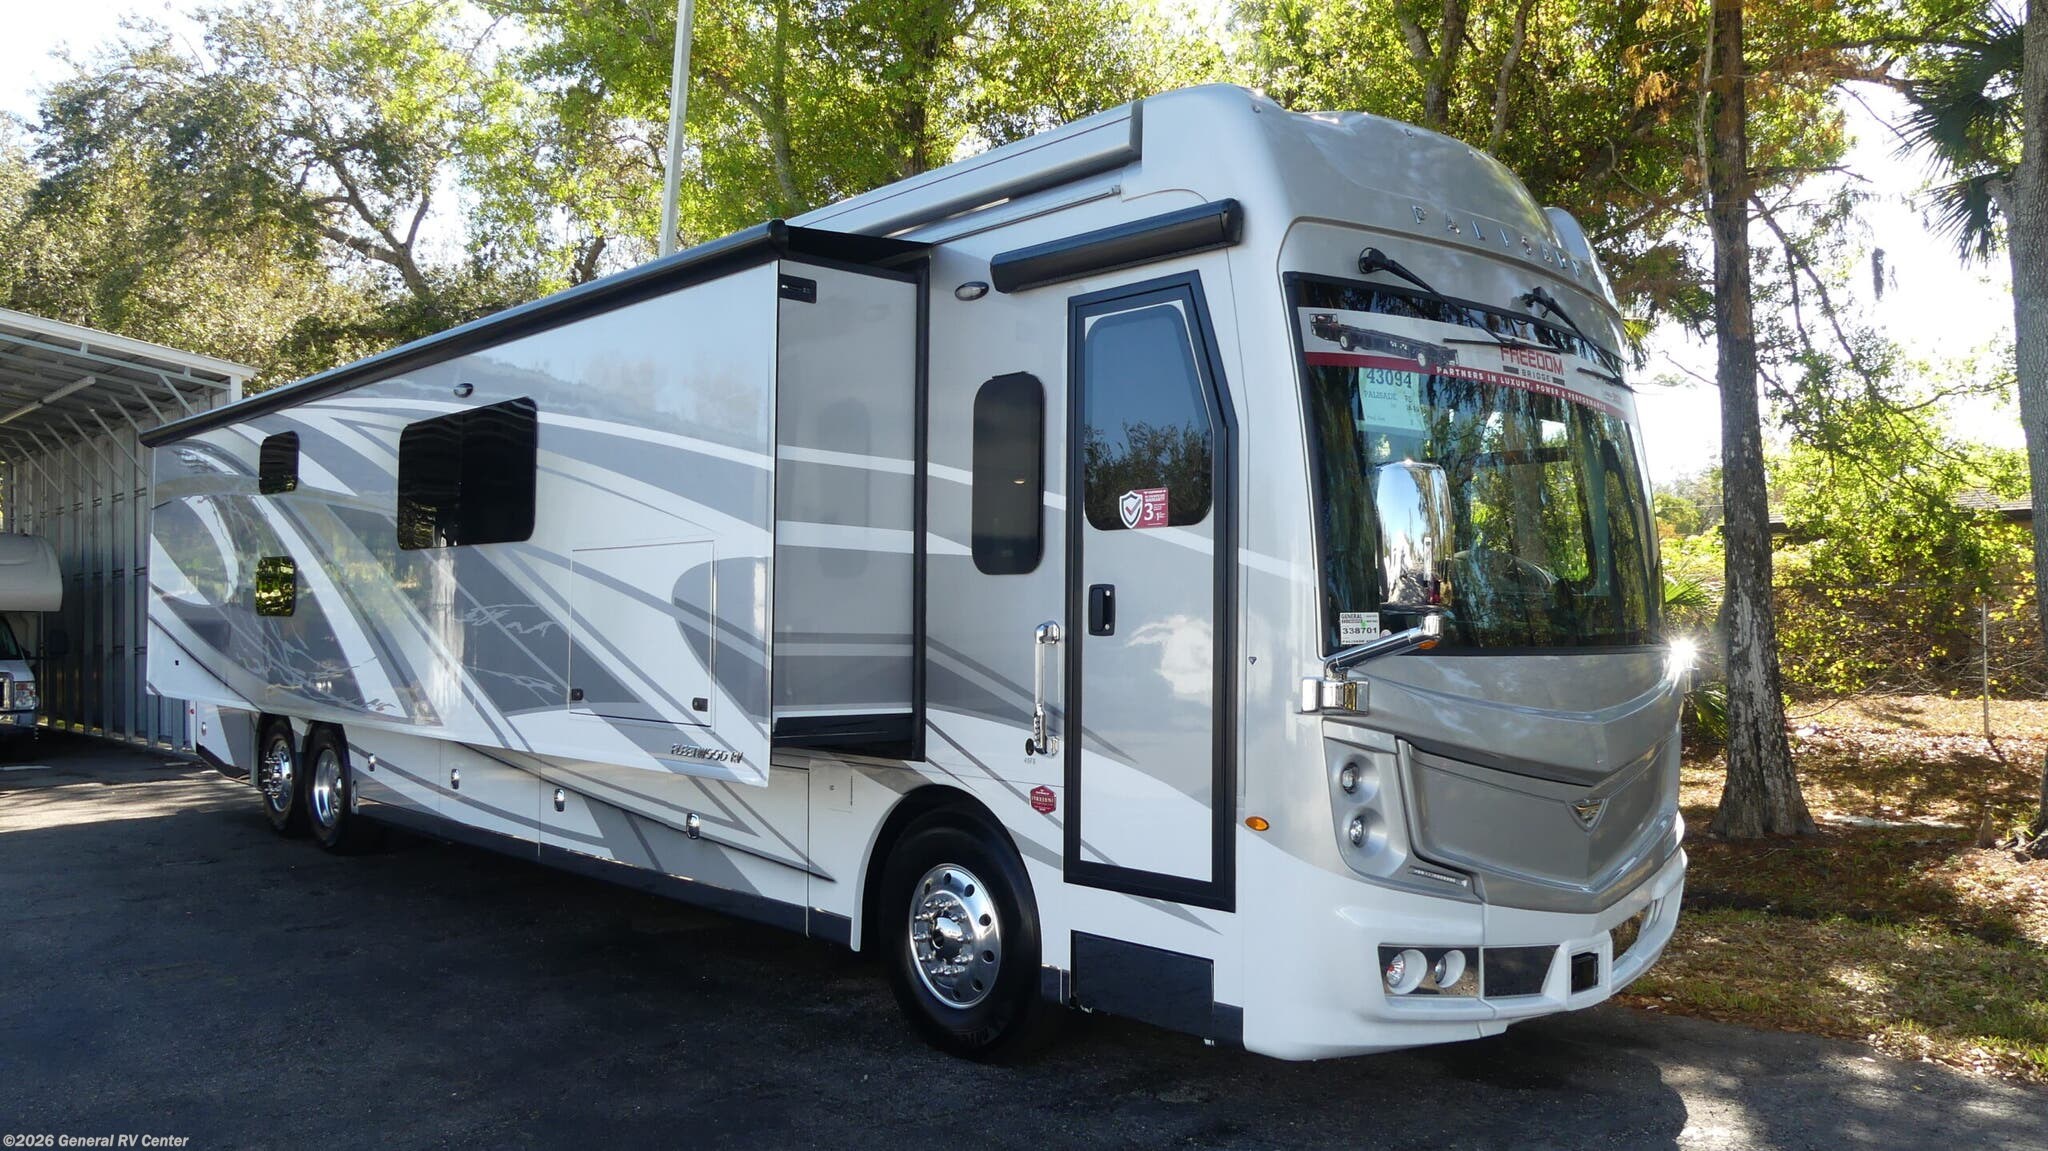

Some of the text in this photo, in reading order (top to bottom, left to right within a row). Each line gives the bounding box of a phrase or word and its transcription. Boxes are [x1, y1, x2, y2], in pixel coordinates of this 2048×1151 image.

[1501, 345, 1564, 376] FREEDOM
[1366, 368, 1412, 388] 43094
[1436, 366, 1484, 380] PARTNERS
[1487, 374, 1497, 382] IN
[1536, 383, 1560, 396] POWER
[1144, 503, 1154, 520] 3
[671, 744, 744, 764] FLEETWOOD RV
